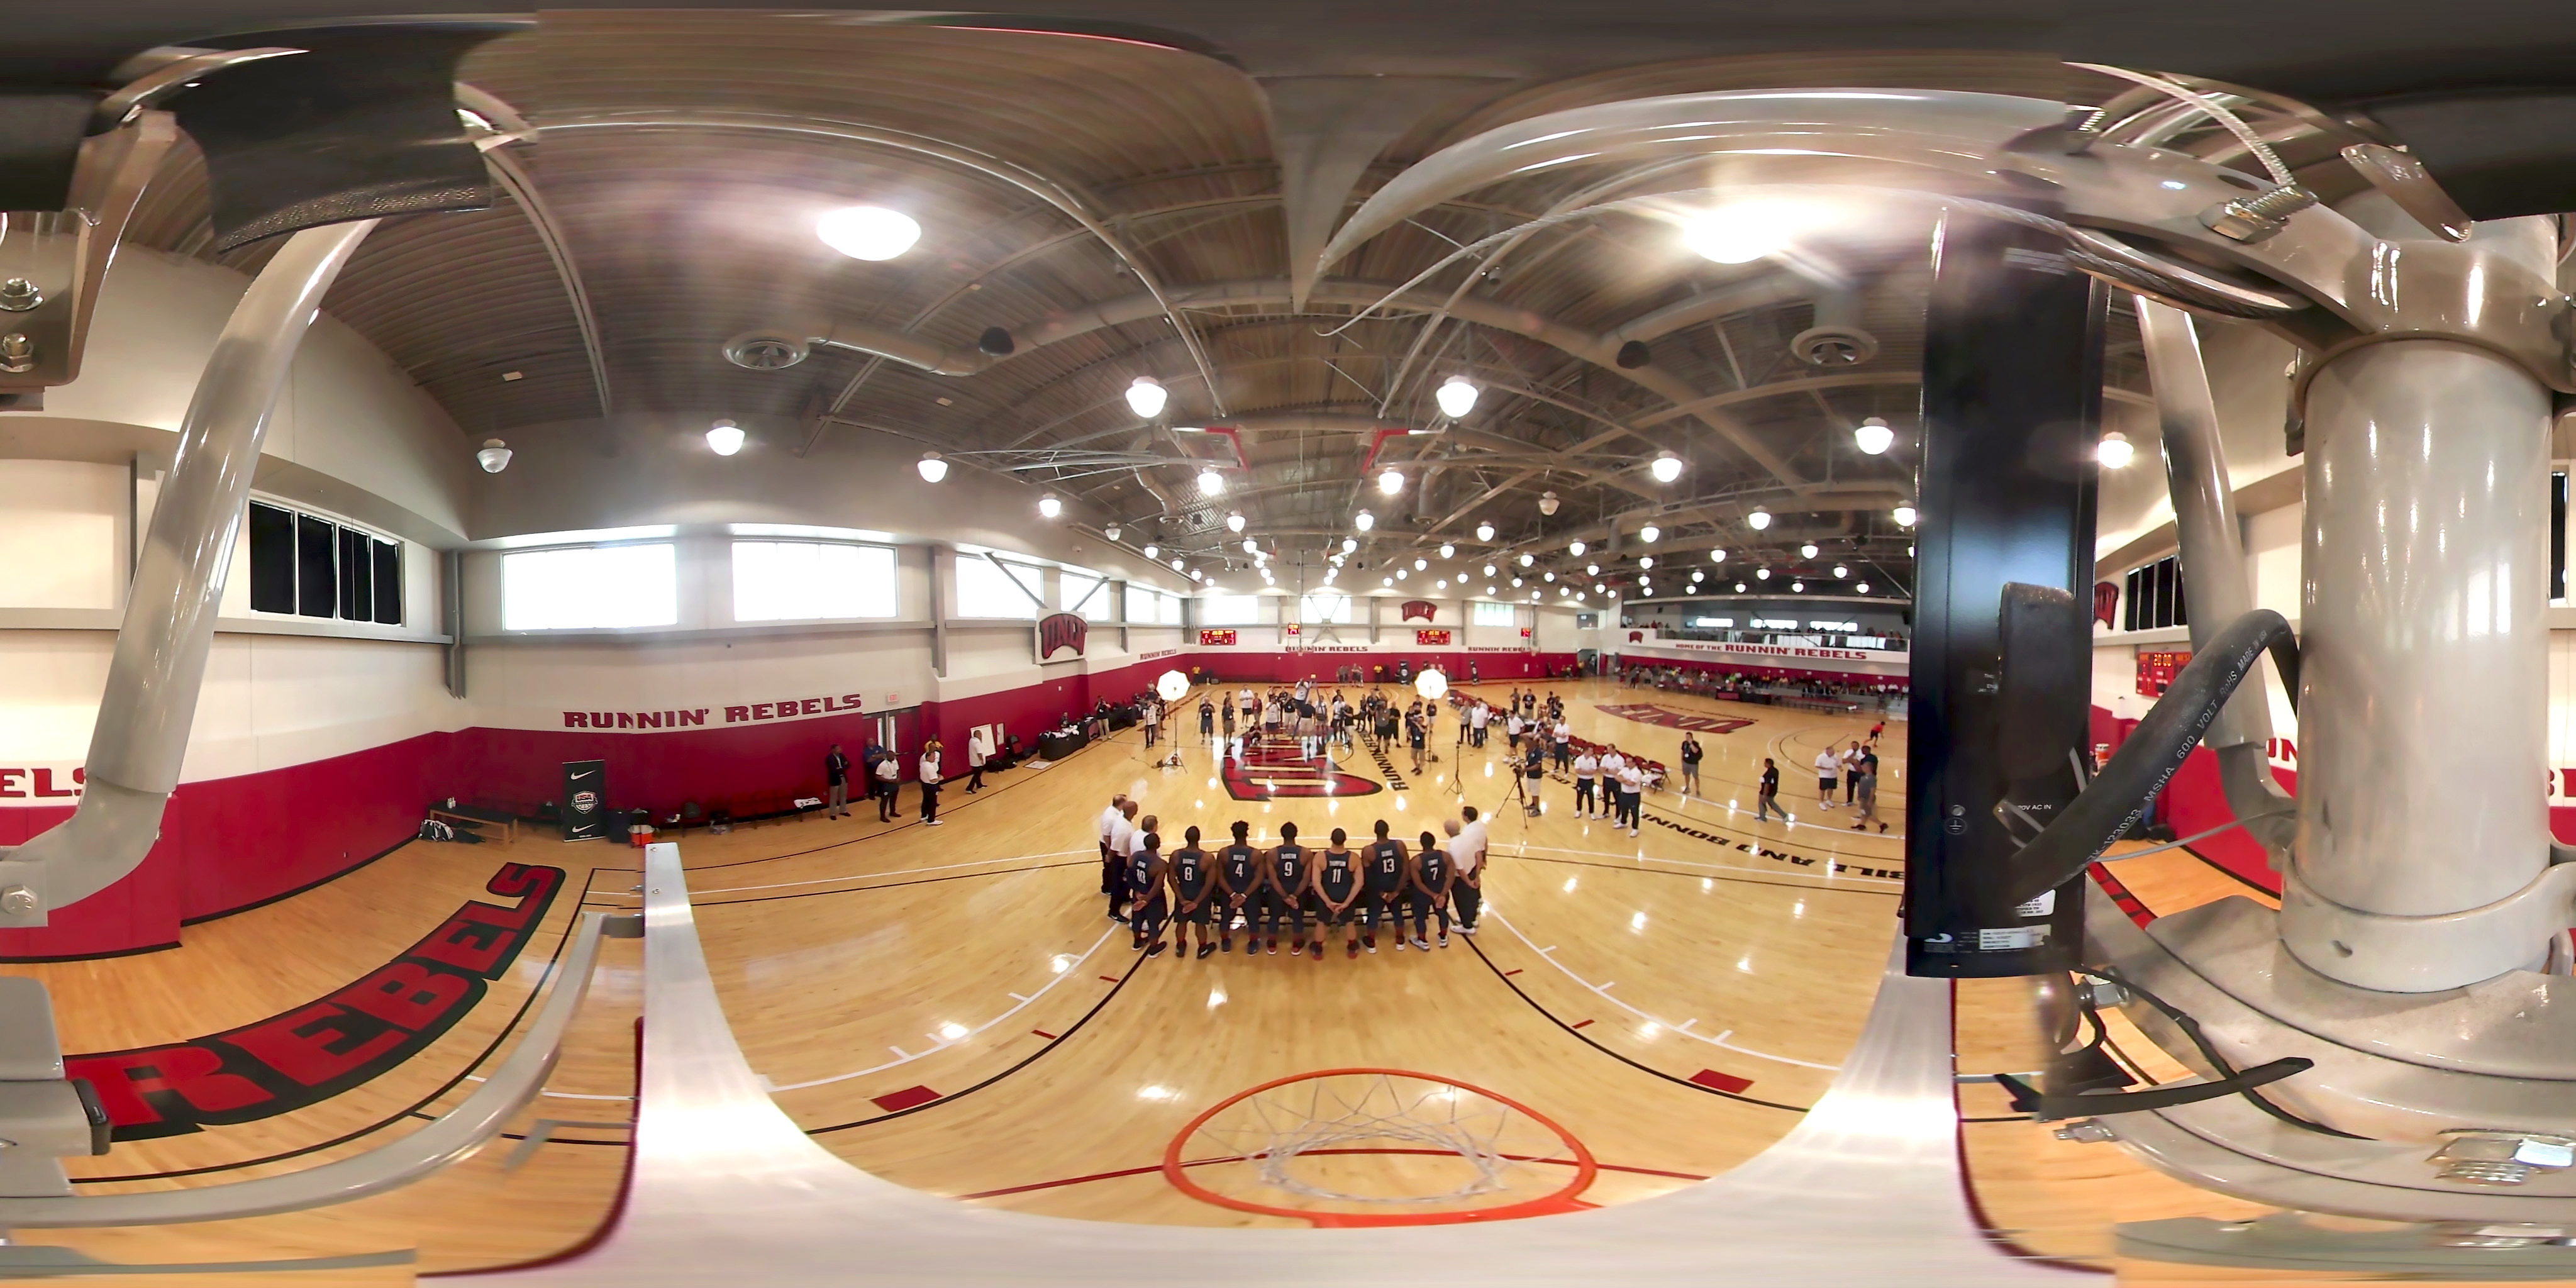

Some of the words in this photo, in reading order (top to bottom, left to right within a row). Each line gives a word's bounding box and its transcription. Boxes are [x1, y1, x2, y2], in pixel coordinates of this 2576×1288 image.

[1040, 613, 1087, 659] UNLV
[1725, 644, 1790, 655] RUNNIN'
[1794, 647, 1867, 660] REBELS
[563, 708, 709, 729] RUNNIN'
[724, 694, 862, 723] REBELS
[2143, 767, 2175, 802] MSHA
[2177, 735, 2196, 758] 600
[2197, 699, 2218, 730] VOLT
[2237, 647, 2254, 671] MADE
[1184, 867, 1192, 881] 8
[1235, 863, 1243, 877] 4
[1284, 862, 1293, 877] 9
[1382, 858, 1394, 874] 13
[1430, 867, 1438, 880] 7
[1136, 869, 1146, 885] 10
[1332, 869, 1341, 883] 11
[64, 862, 566, 1141] REBELS
